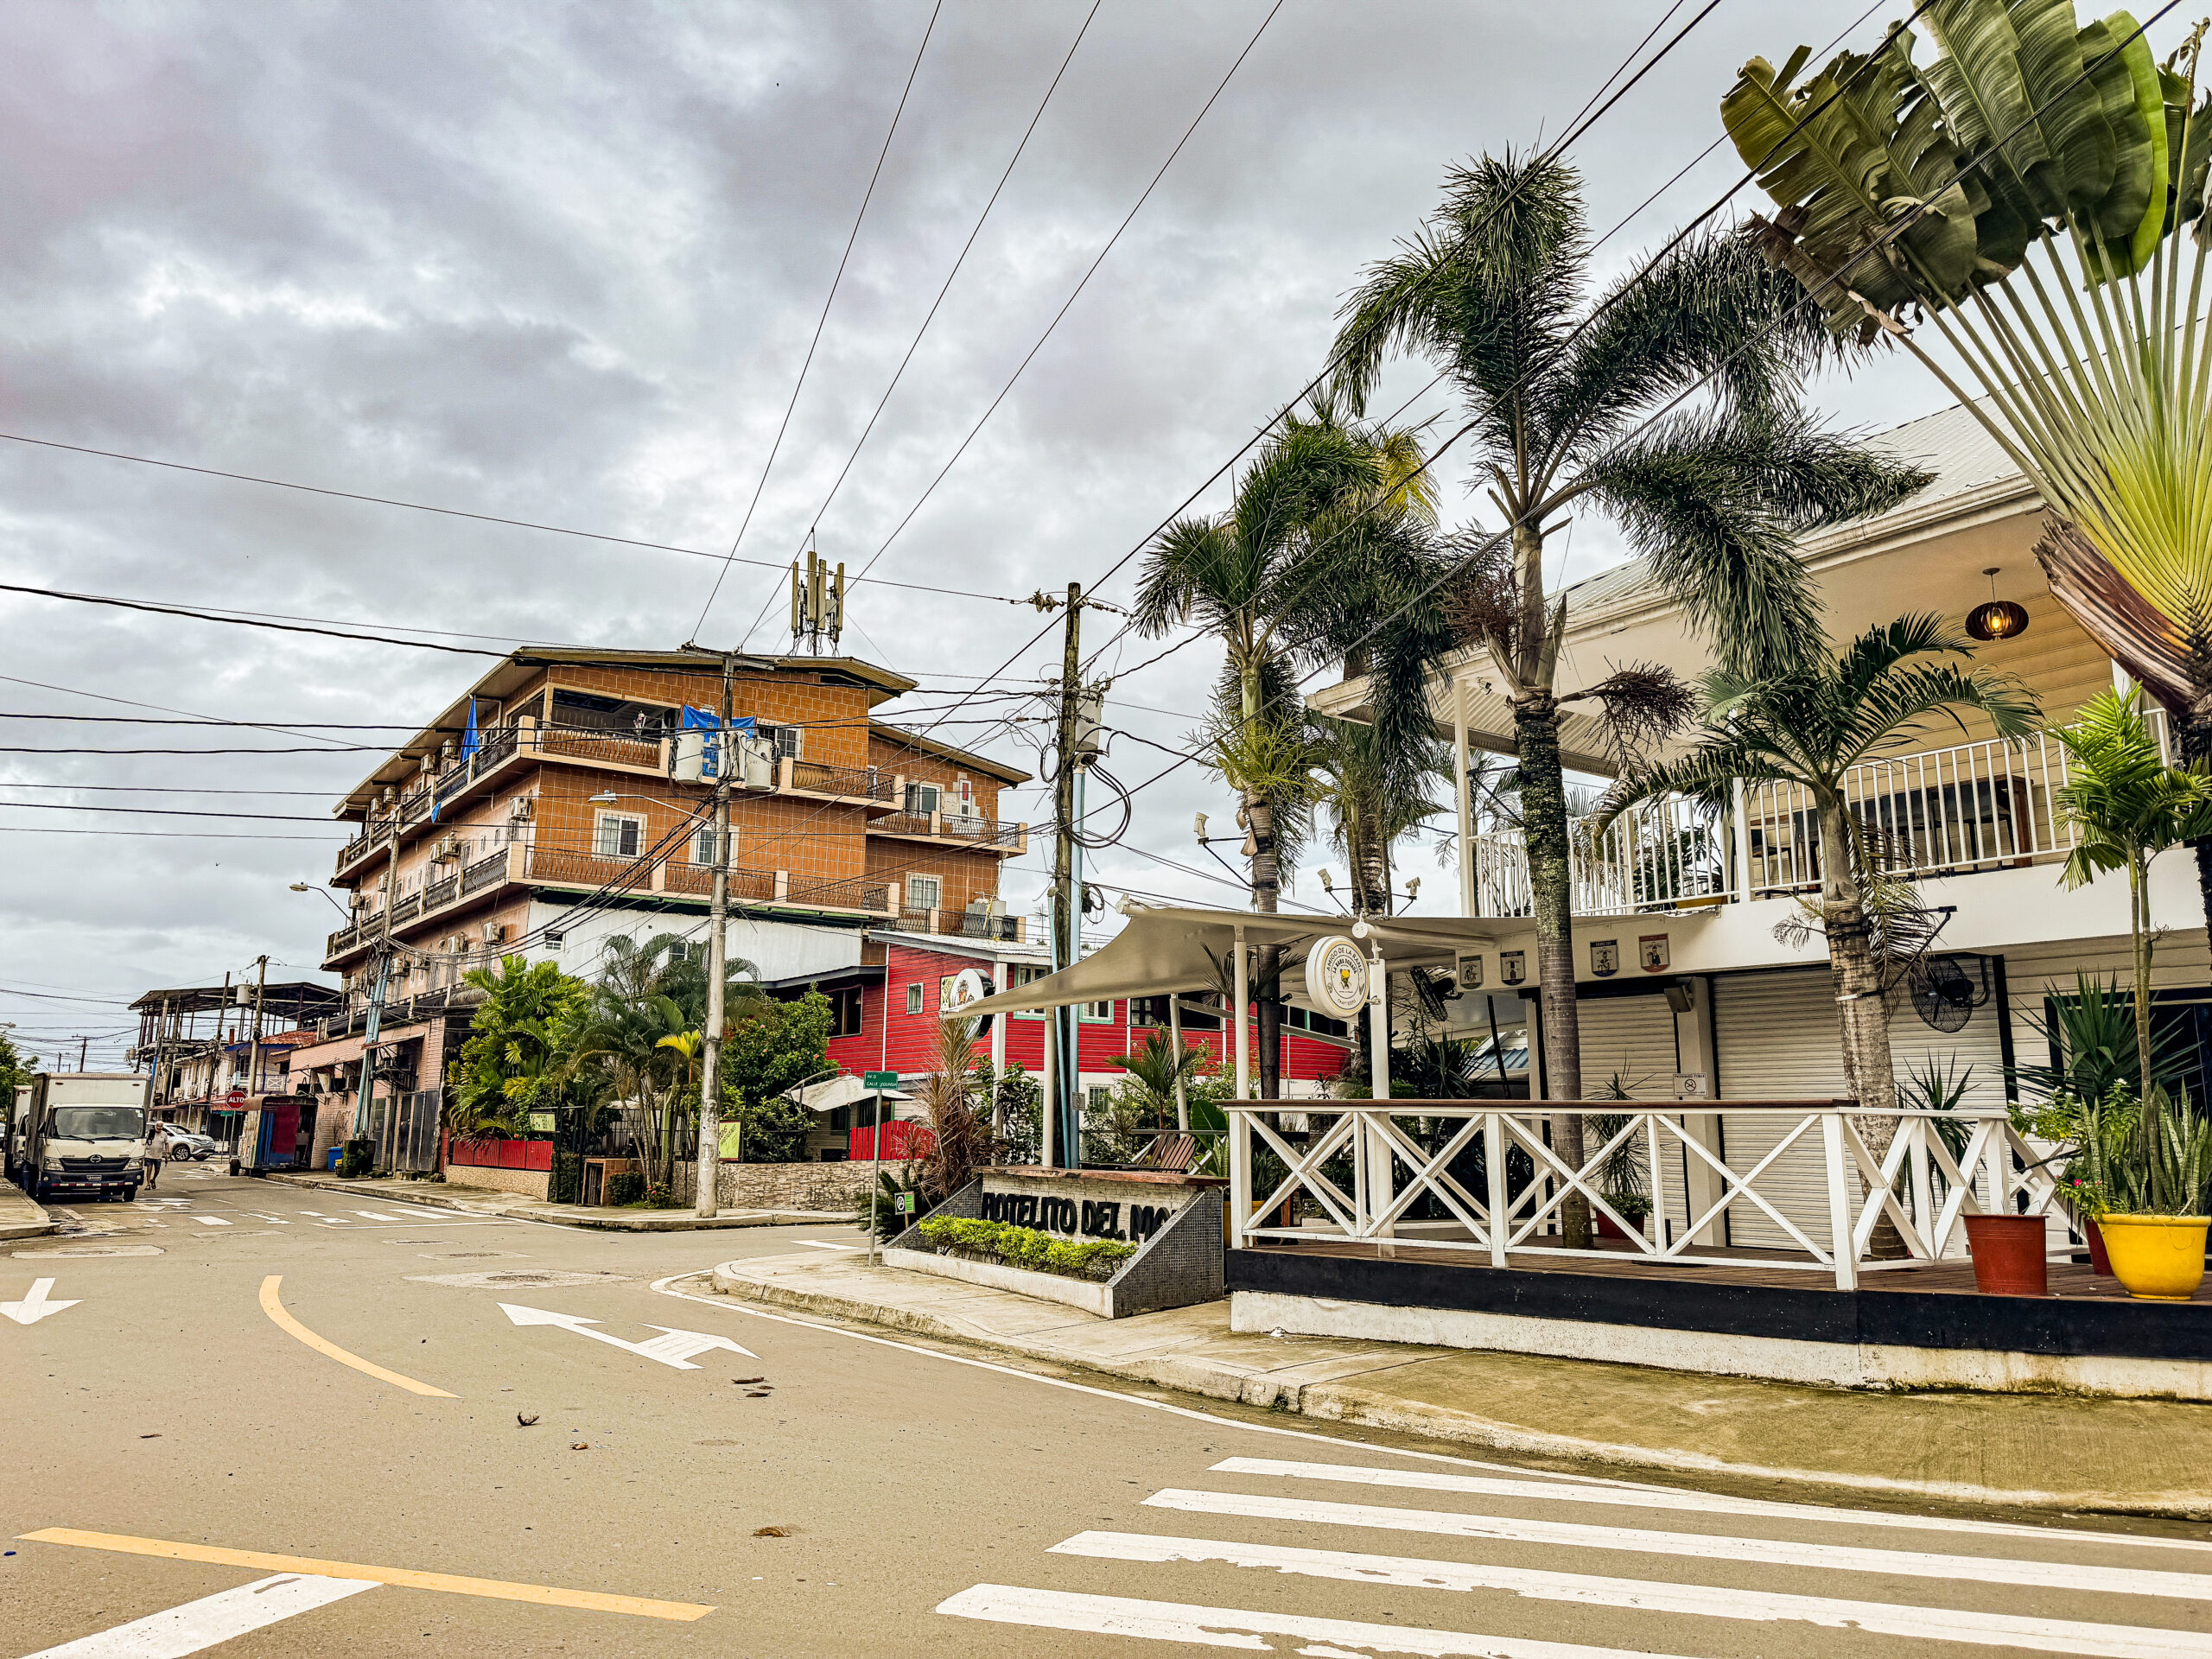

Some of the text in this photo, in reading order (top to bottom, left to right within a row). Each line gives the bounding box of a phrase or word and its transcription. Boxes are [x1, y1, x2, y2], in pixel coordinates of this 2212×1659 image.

[1326, 950, 1338, 972] AMIGO
[982, 1192, 1176, 1243] HOTELITO DEL MA
